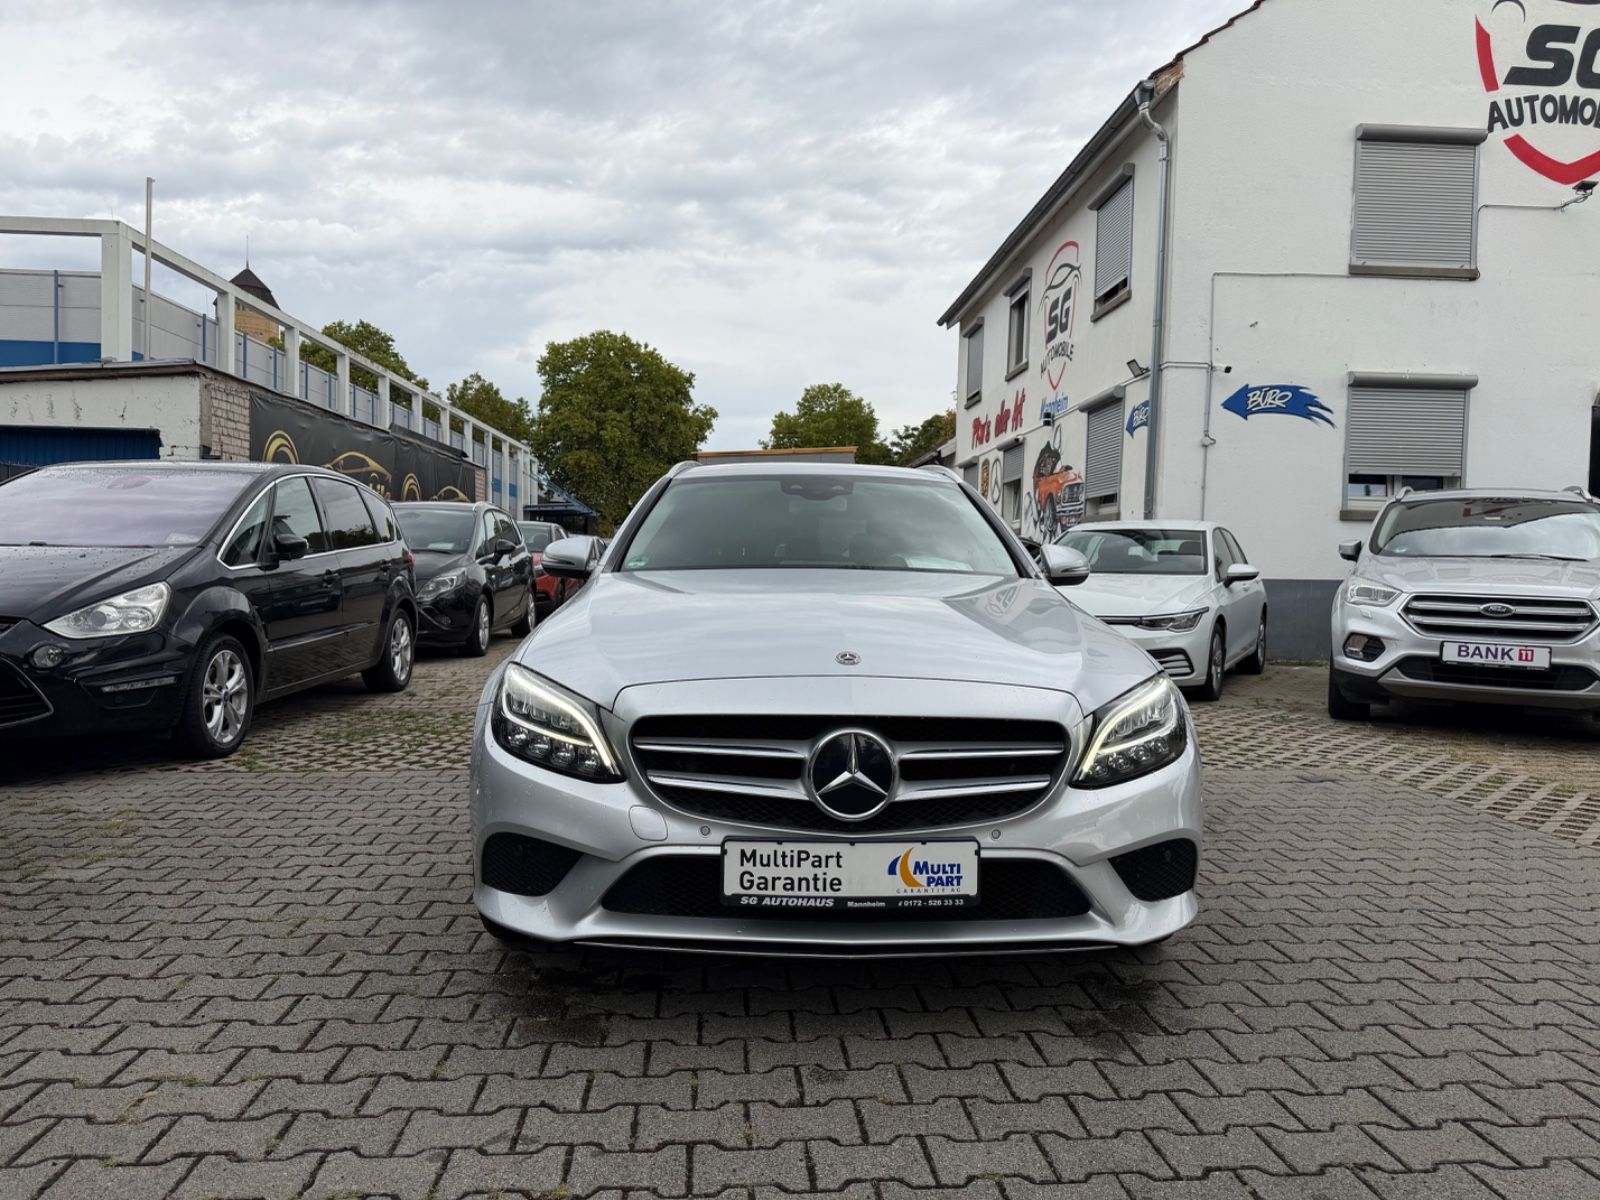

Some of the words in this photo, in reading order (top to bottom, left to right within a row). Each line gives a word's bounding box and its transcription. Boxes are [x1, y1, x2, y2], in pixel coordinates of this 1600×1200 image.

[1046, 286, 1072, 345] SG
[1246, 387, 1293, 411] BÜRO
[1457, 645, 1515, 661] BANK
[740, 848, 843, 869] MultiPart
[912, 860, 961, 876] MULTI
[739, 870, 843, 893] Garantie
[926, 875, 963, 888] PART
[740, 896, 759, 905] SG
[762, 896, 835, 907] AUTOHAUS
